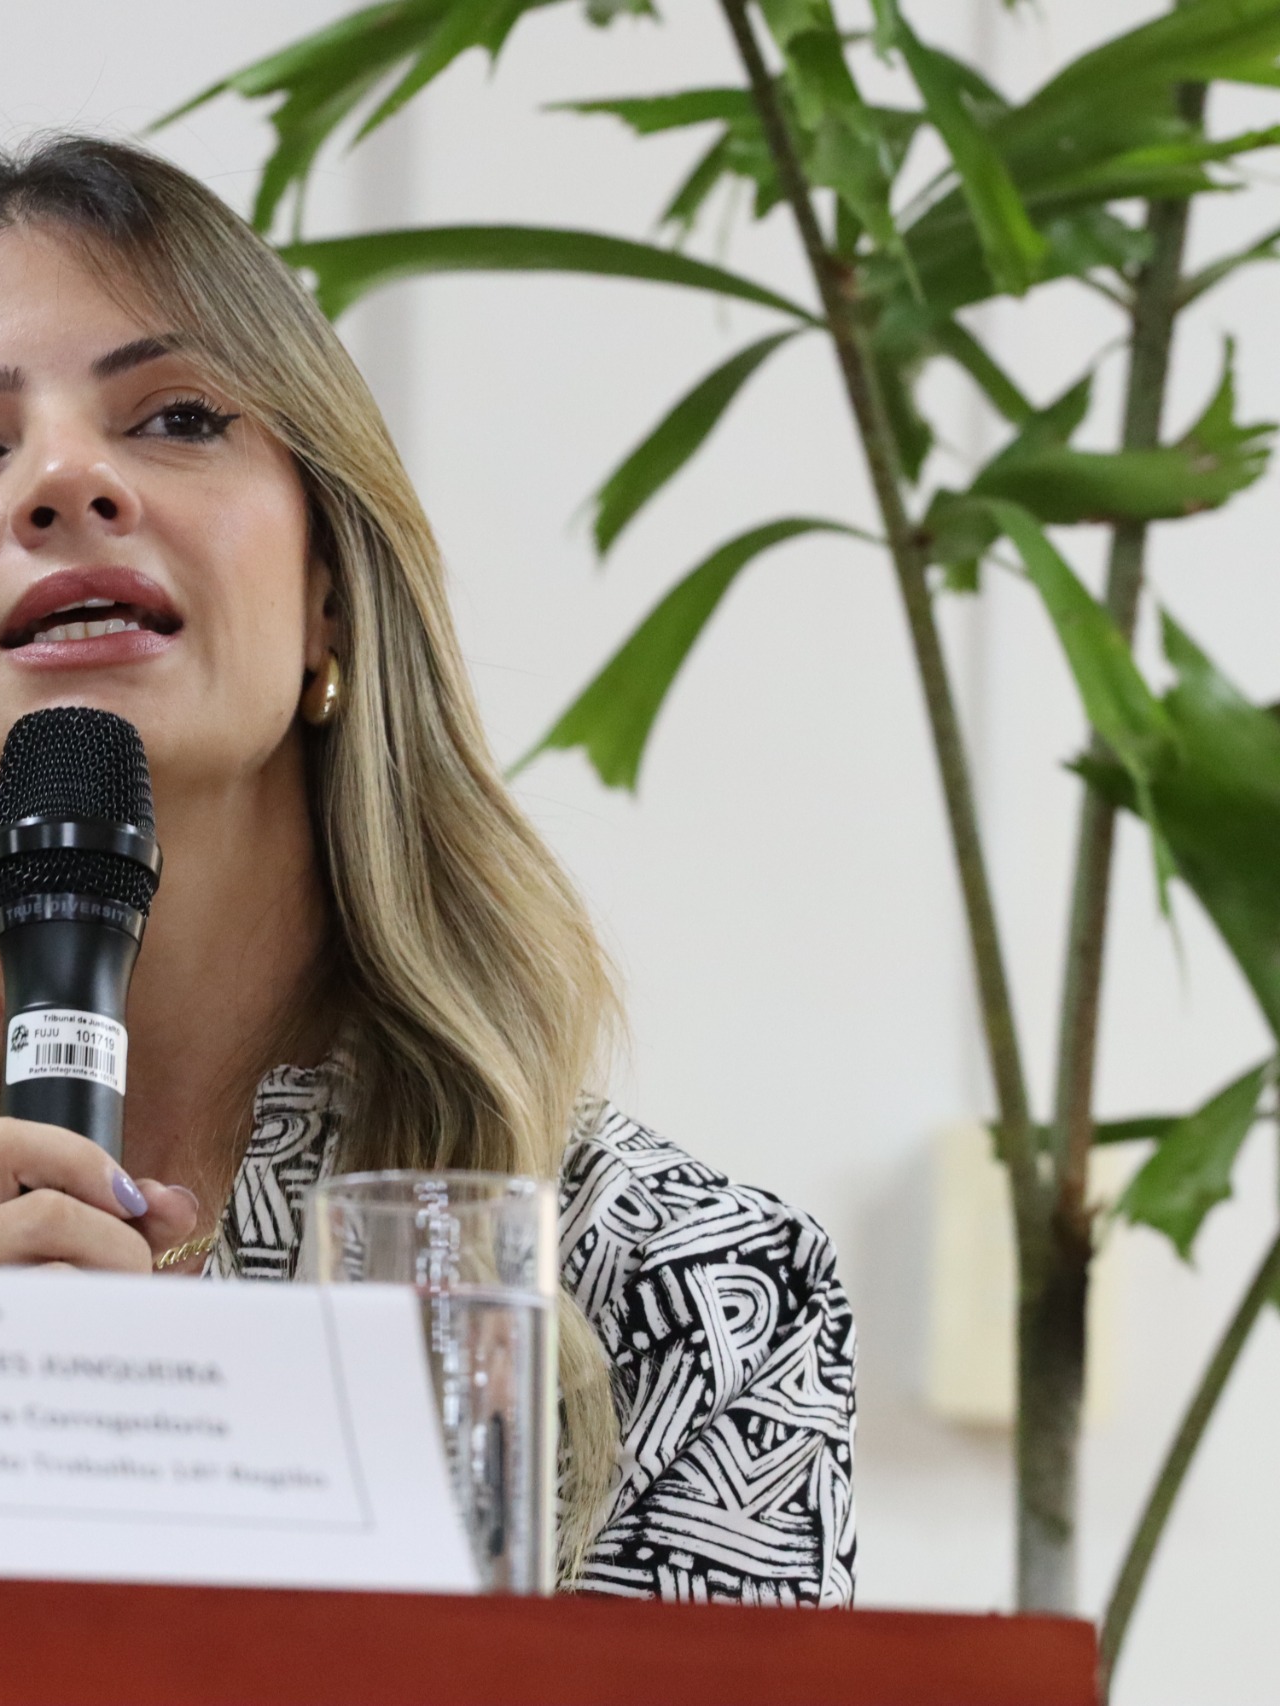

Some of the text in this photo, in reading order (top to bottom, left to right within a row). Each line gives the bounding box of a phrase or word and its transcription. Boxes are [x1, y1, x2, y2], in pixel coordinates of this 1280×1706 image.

[6, 900, 132, 926] TRUE DIVERSITY
[43, 1015, 75, 1023] Tribunal
[34, 1028, 115, 1051] FUJU 101719
[29, 1067, 47, 1075] Parte
[49, 1066, 88, 1076] integrante
[39, 1355, 224, 1385] JUNQUEIRA
[22, 1405, 230, 1438] Corregedoria
[32, 1451, 163, 1481] Trabalho
